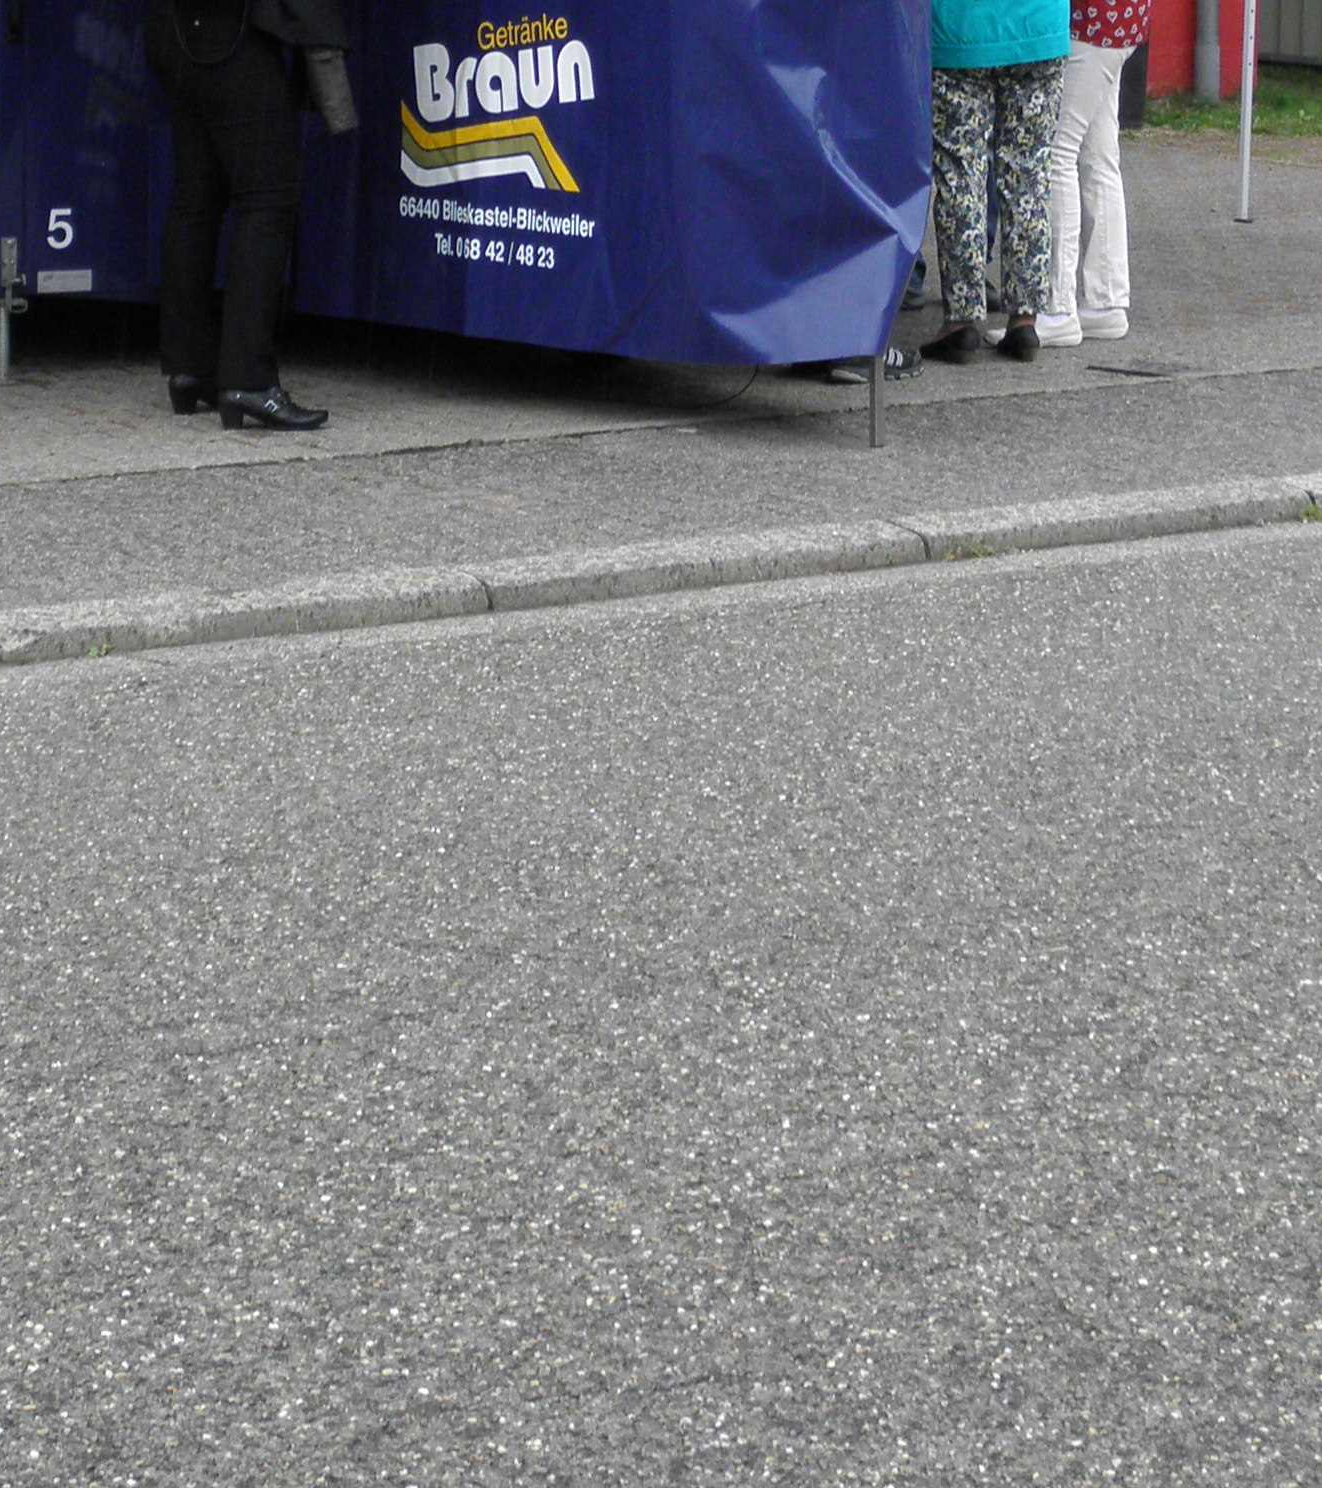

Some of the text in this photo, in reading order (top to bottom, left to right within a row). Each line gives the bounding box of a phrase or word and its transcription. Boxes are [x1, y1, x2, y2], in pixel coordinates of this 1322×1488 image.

[478, 13, 568, 50] Getränke
[413, 39, 595, 123] Braun
[47, 208, 73, 250] 5
[399, 196, 595, 238] 66440 Blieskastel-Blickweiler
[434, 233, 454, 256] Tel.
[485, 240, 505, 263] 42
[515, 244, 534, 266] 48
[537, 246, 555, 269] 23
